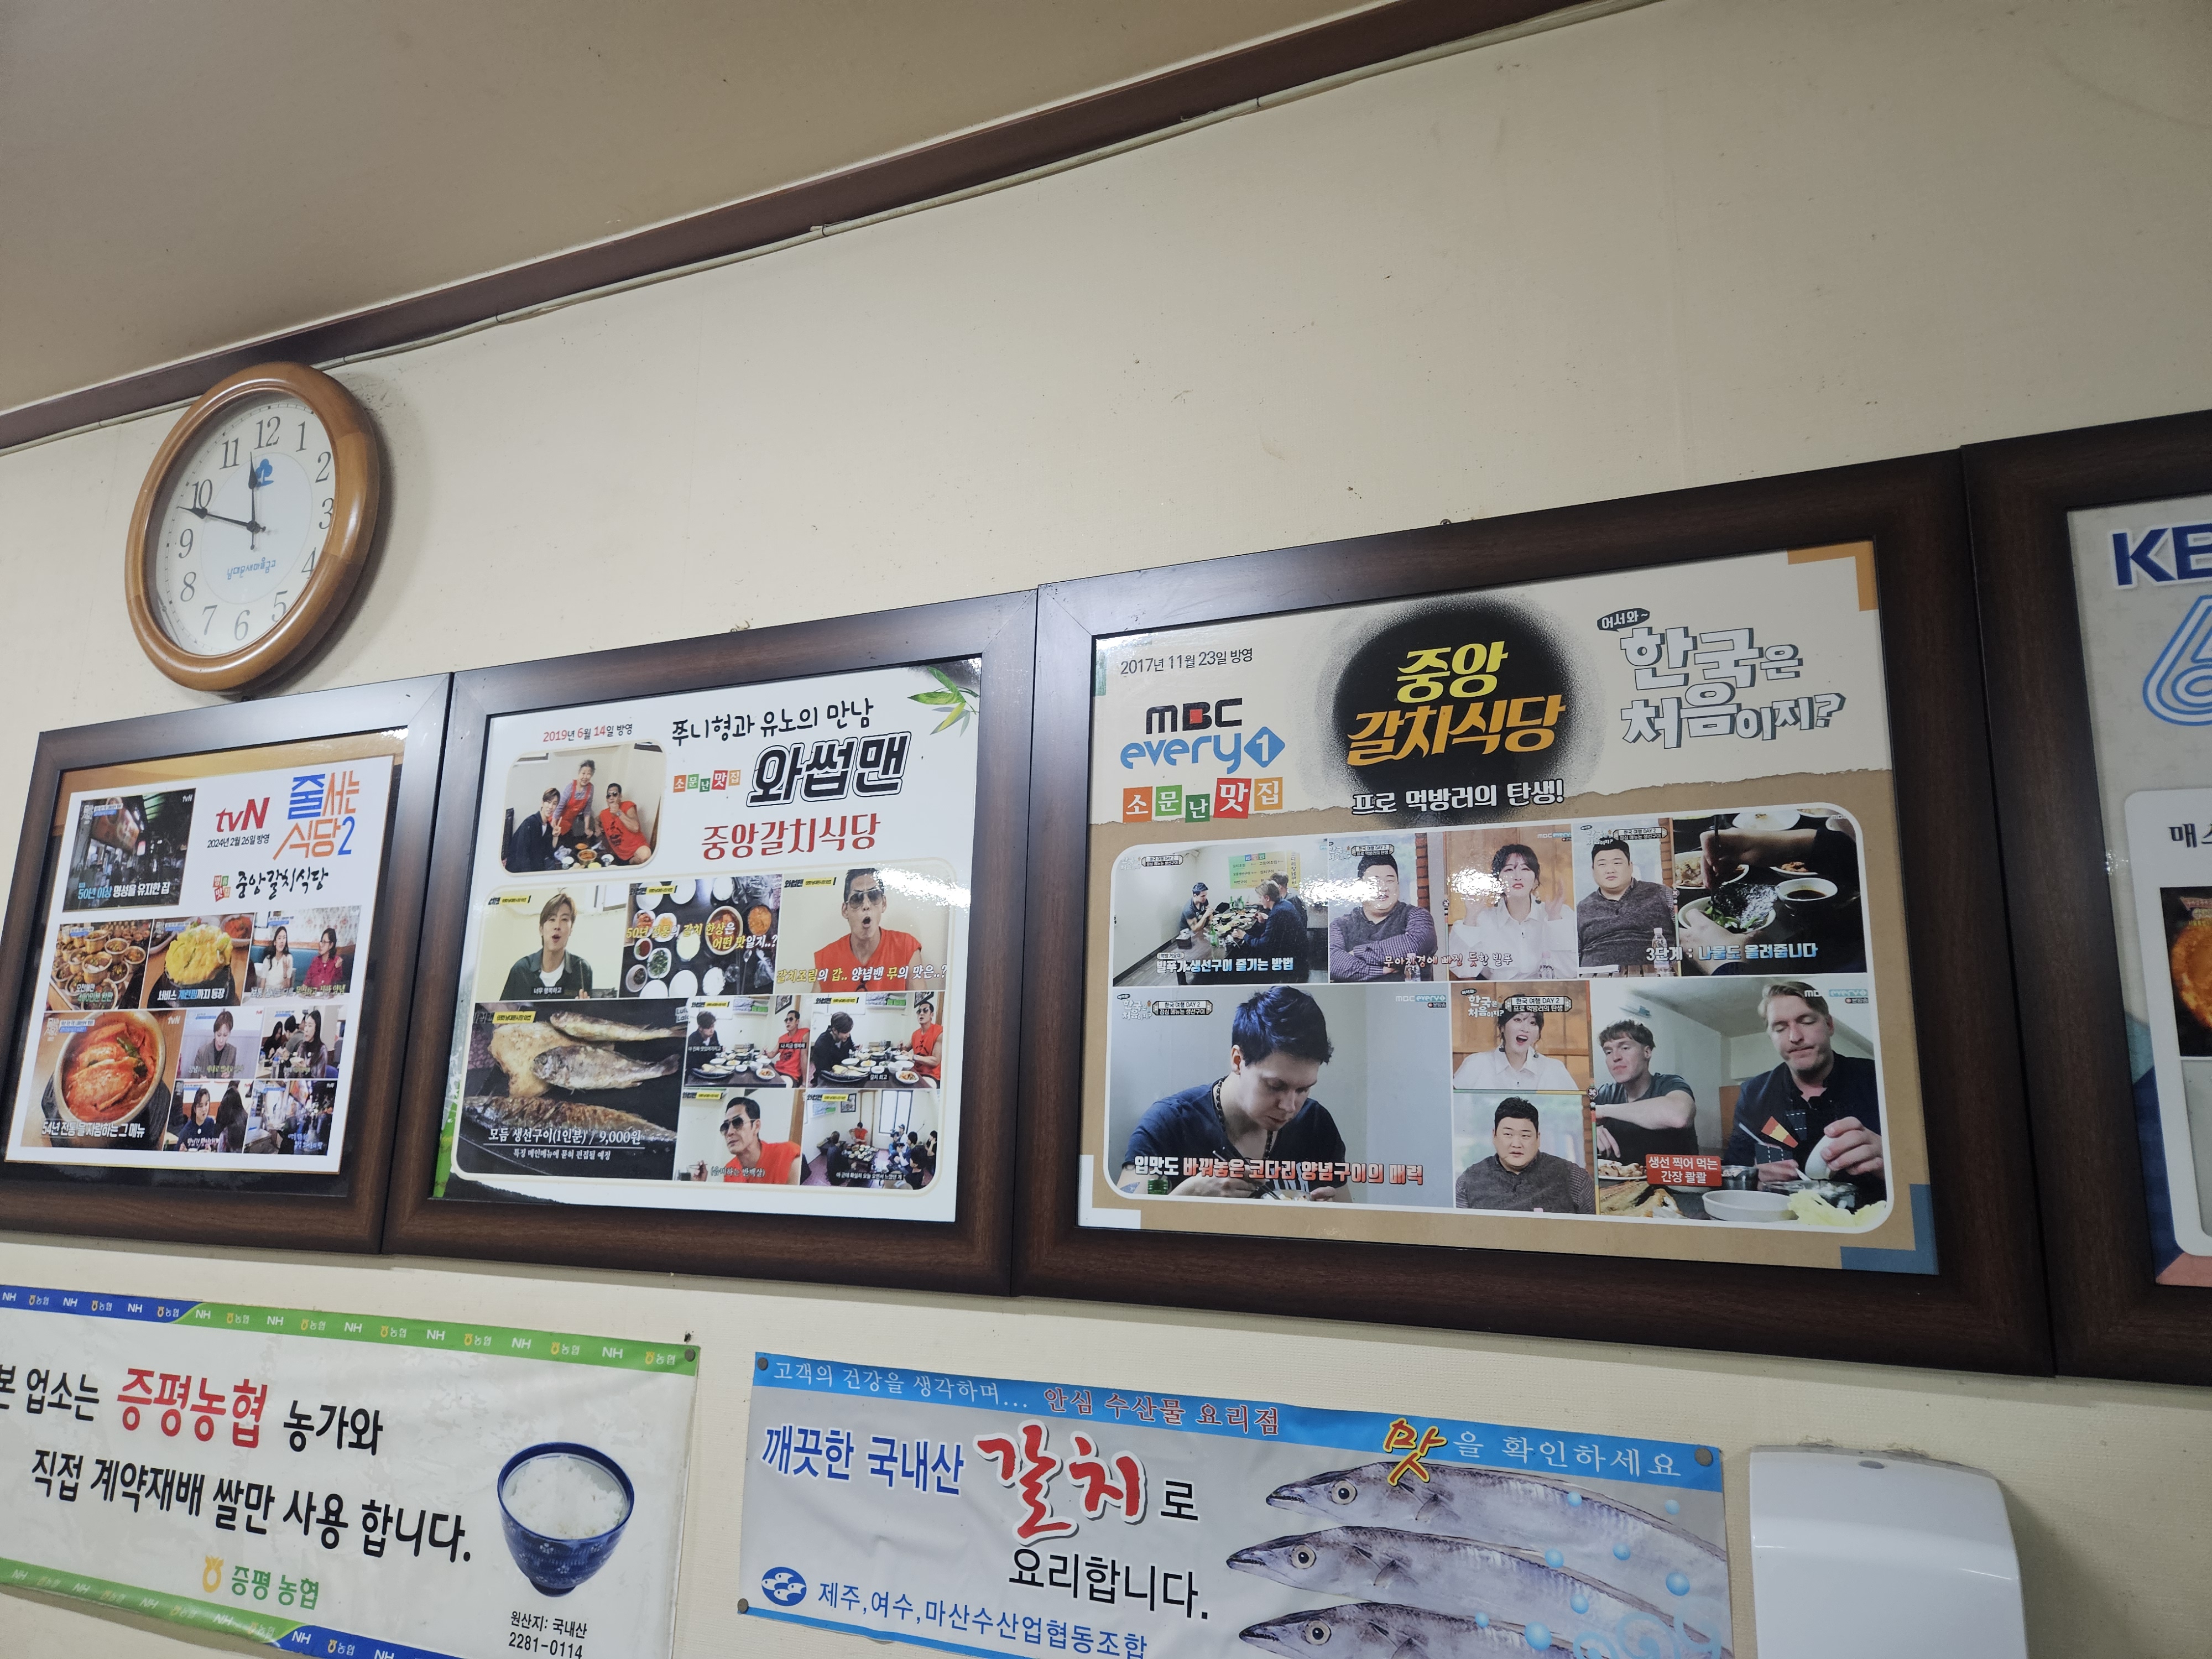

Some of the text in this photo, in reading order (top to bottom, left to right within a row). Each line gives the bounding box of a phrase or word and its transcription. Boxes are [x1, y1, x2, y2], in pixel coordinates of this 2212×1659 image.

[254, 416, 281, 449] 12
[296, 421, 306, 451] 1
[220, 438, 240, 469] 11
[315, 452, 331, 483] 2
[192, 479, 213, 508] 10
[319, 498, 334, 529] 3
[179, 529, 193, 558] 9
[301, 547, 317, 579] 4
[180, 572, 196, 602] 8
[202, 605, 217, 635] 7
[272, 590, 288, 622] 5
[1601, 611, 1648, 629] 어서와~
[234, 609, 250, 640] 6
[1120, 648, 1253, 675] 2017년 11월 23일 방영
[1397, 641, 1509, 703] 중앙
[1620, 626, 1803, 691] 한국은
[760, 707, 817, 738] 유노의
[826, 697, 874, 728] 만남
[1146, 698, 1243, 734] MBC
[1347, 694, 1566, 766] 갈치식당
[1620, 681, 1846, 749] 처음이지?
[543, 723, 633, 742] 2019년 6월 14일 방영
[748, 733, 910, 806] 와썹맨
[182, 794, 192, 802] tvN
[288, 770, 359, 820] 줄서는
[1352, 779, 1565, 815] 프로 먹방러의 탄생!
[216, 797, 270, 832] tvN
[207, 833, 270, 848] 2024년 2월 26일 방영
[273, 816, 355, 860] 식당2
[701, 813, 881, 860] 중앙갈치식당
[78, 881, 170, 900] 50년 이상 명성을 유지한 집
[236, 866, 329, 900] 중앙갈치식당
[626, 922, 736, 939] 50년 전통의 갈치 한상은
[712, 934, 778, 950] 어떤 맛일지..?
[1156, 957, 1293, 973] 빌푸가 생선구이 즐기는 방법
[1384, 954, 1438, 967] 무아지경에
[1468, 951, 1489, 967] 듯한
[1493, 952, 1512, 966] 빌푸
[1646, 943, 1818, 961] 3단계 나물도 올려줍니다
[776, 964, 947, 983] 갈치조림의 갑.. 양념밴 무의 맛은..?
[157, 990, 177, 1001] 서비스
[1123, 1000, 1147, 1012] 한국은
[1468, 995, 1499, 1008] 한국은
[168, 1015, 181, 1025] tvN
[1122, 1010, 1152, 1021] 처음이지?
[1468, 1006, 1505, 1018] 처음이지?
[42, 1121, 145, 1138] 54년 그 메뉴
[488, 1128, 641, 1145] 모듬 생선구이(1인분) 9,000원
[528, 1148, 560, 1159] 메인메뉴에
[597, 1150, 611, 1161] 예정
[1648, 1156, 1718, 1171] 생선 찍어 먹는
[1134, 1155, 1423, 1186] 입맛도 바꿔놓은 코다리 양념구이의 매력
[1661, 1171, 1707, 1184] 간장 콸콸
[2, 1291, 249, 1324] NH 농협 NH 농협 NH 농협 NH 농협
[26, 1368, 100, 1422] 업소는
[117, 1368, 268, 1448] 증평농협
[284, 1400, 383, 1455] 농가와
[774, 1360, 833, 1387] 고객의
[842, 1368, 905, 1395] 건강을
[914, 1374, 1028, 1408] 생각하며...
[1044, 1386, 1093, 1416] 안심
[1105, 1393, 1185, 1426] 수산물
[1196, 1404, 1280, 1436] 요리점
[1501, 1436, 1682, 1478] 확인하세요
[761, 1425, 854, 1481] 깨끗한
[868, 1436, 964, 1496] 국내산
[32, 1449, 471, 1563] 직접 계약재배 쌀만 사용 합니다.
[1008, 1548, 1209, 1621] 요리합니다.
[510, 1610, 587, 1639] 원산지: 국내산
[509, 1632, 583, 1659] 2281-0114
